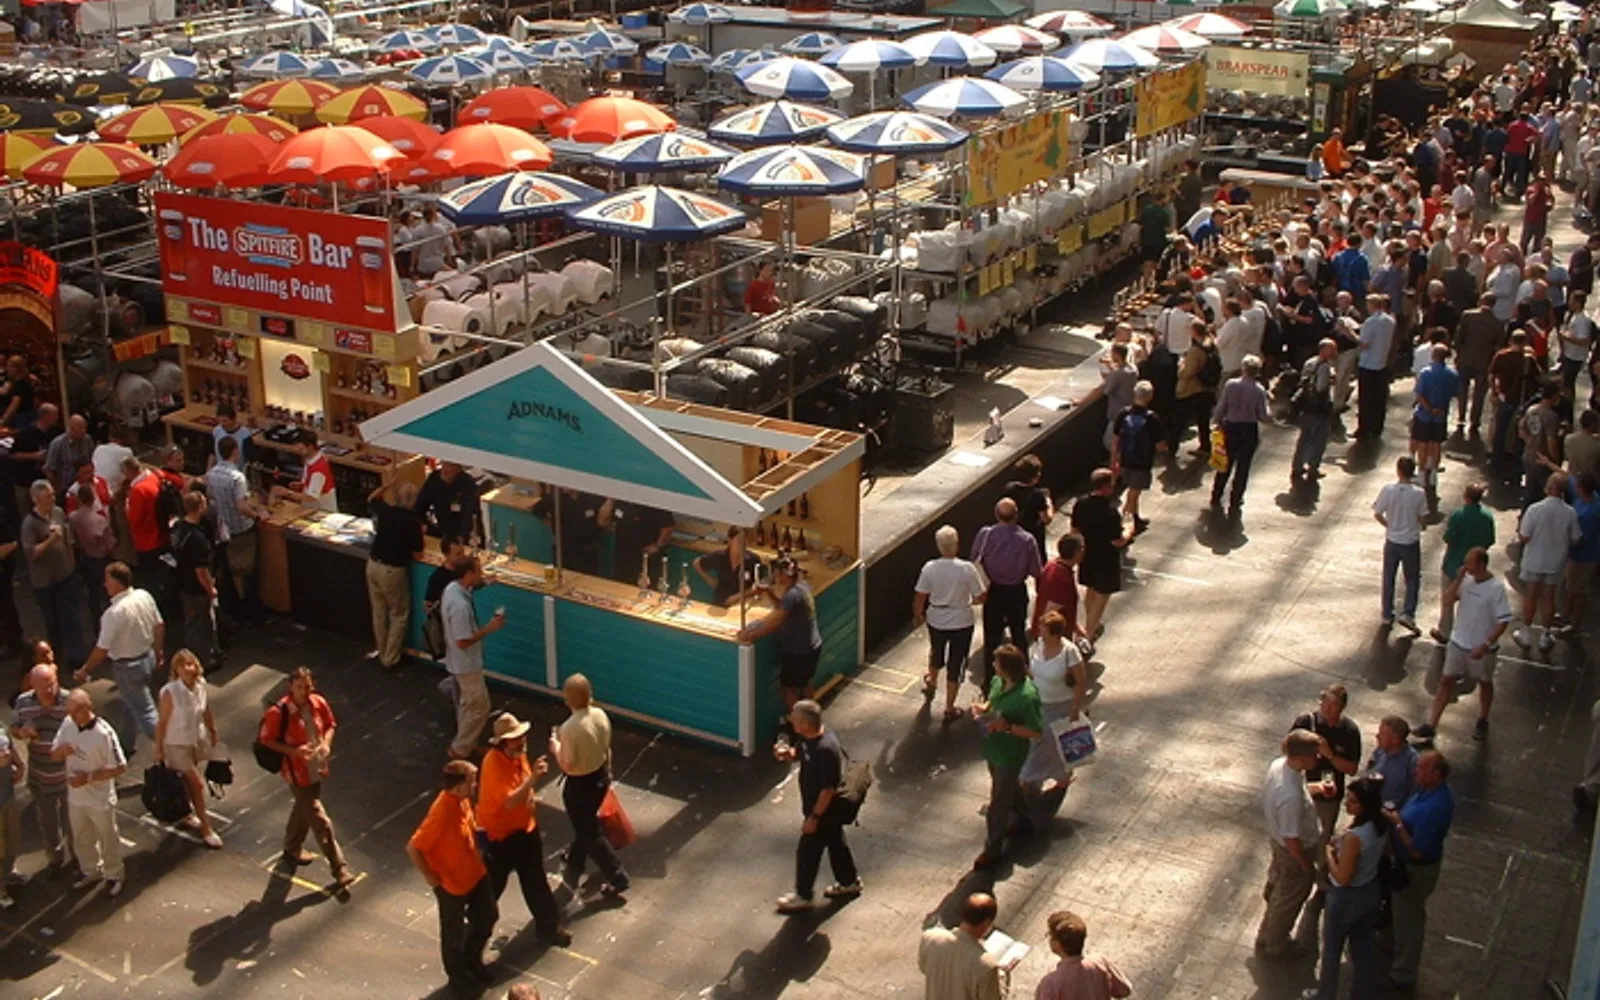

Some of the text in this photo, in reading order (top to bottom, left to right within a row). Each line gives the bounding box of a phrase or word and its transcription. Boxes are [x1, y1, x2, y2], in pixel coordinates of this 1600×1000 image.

[1216, 60, 1288, 77] BRAKSPEAR
[187, 216, 353, 269] The SPITFIRE Bar
[212, 265, 333, 304] Refuelling Point
[506, 400, 584, 435] ADNAMS
